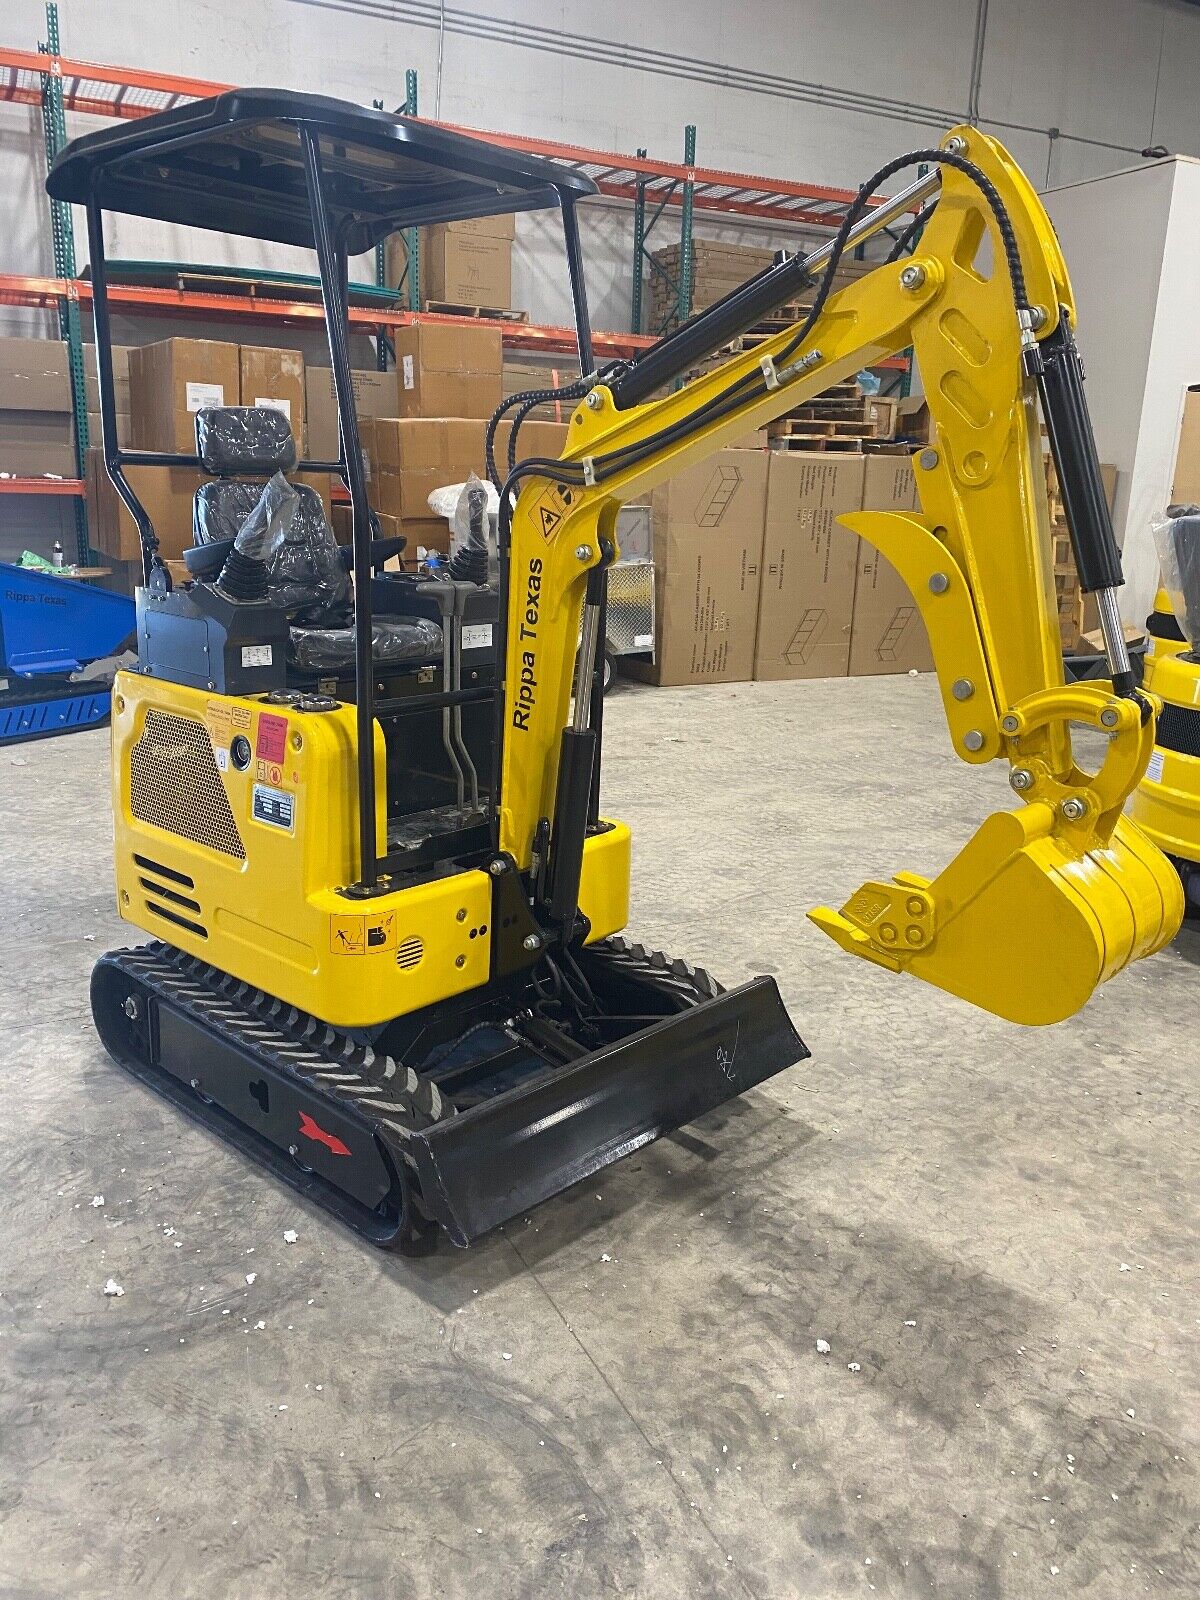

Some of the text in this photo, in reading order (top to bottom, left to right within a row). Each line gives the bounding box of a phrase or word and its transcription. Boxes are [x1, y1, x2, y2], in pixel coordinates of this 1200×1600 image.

[6, 590, 67, 605] Rippa Texas
[512, 557, 543, 732] Rippa Texas
